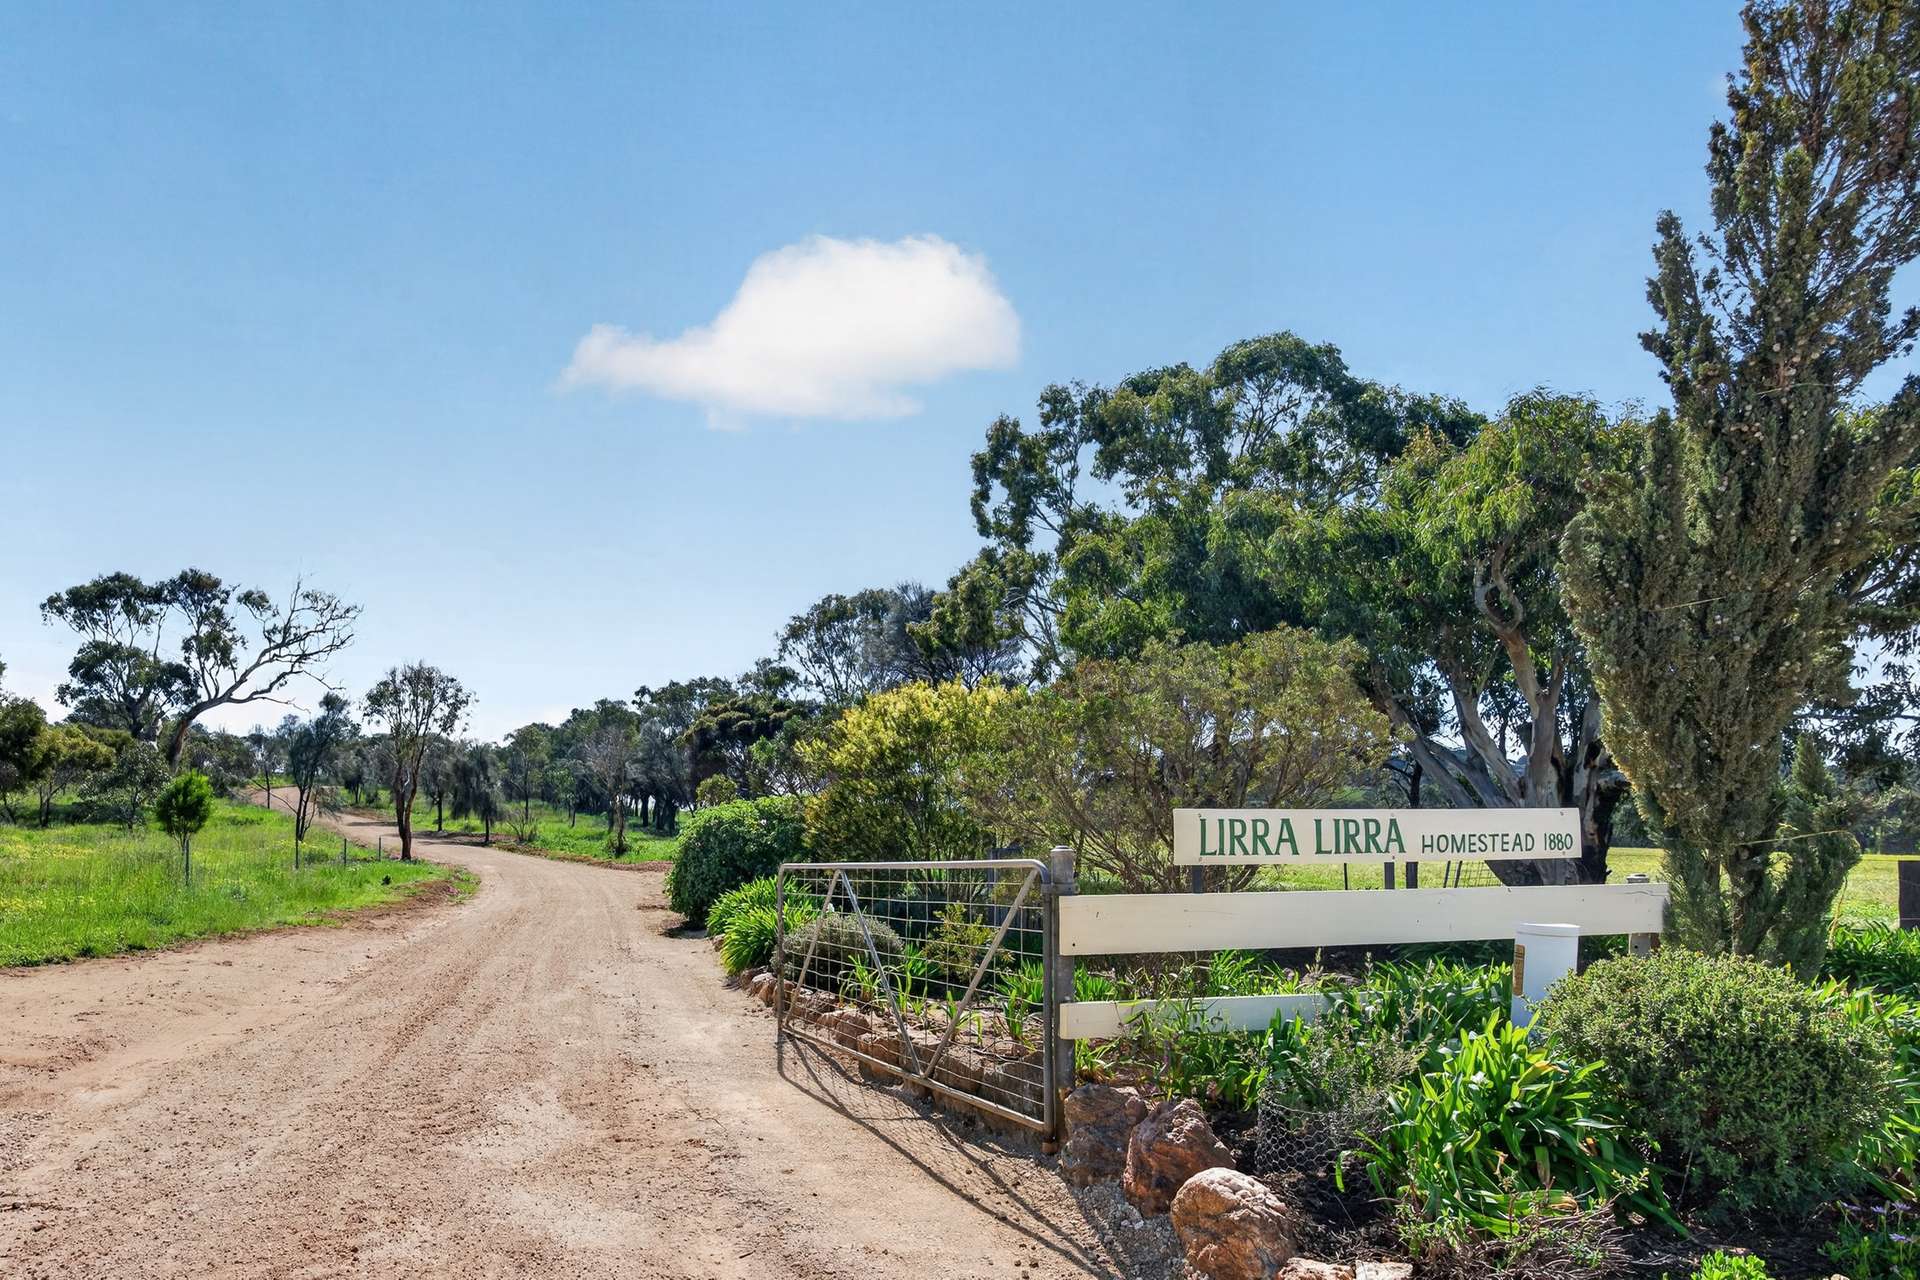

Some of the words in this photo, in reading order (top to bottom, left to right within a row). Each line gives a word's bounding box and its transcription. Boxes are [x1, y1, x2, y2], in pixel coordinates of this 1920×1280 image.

[1200, 818, 1299, 856] LIRRA
[1314, 818, 1406, 855] LIRRA
[1422, 833, 1535, 854] HOMESTEAD
[1543, 832, 1573, 851] 1880
